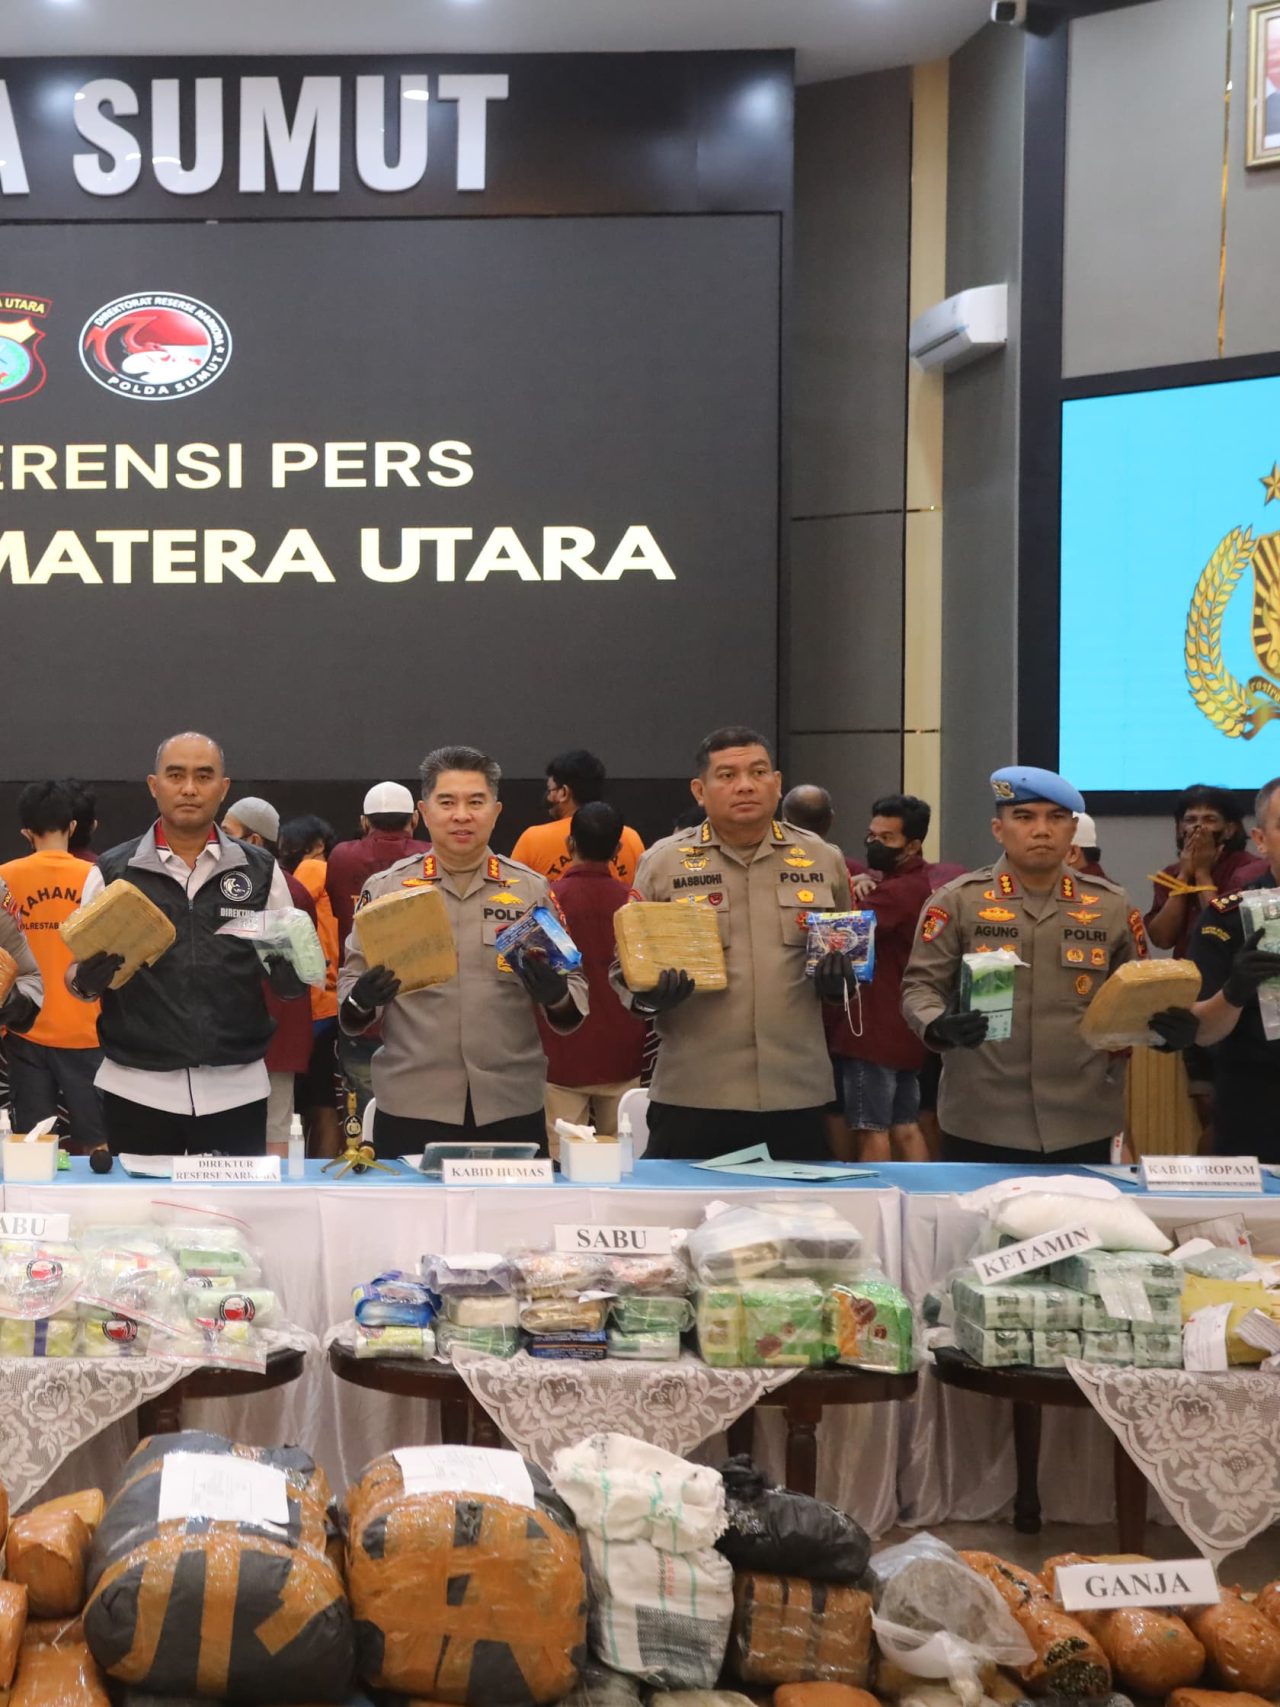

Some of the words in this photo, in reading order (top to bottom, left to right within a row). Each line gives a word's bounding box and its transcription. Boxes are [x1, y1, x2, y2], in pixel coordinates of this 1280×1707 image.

[72, 74, 509, 196] SUMUT
[5, 297, 45, 314] UTARA
[94, 297, 153, 326] DIREKTORAT
[154, 297, 197, 314] RESERSE
[107, 376, 169, 395] POLDA
[175, 355, 224, 392] SUMUT
[272, 440, 475, 488] PERS
[360, 525, 677, 582] UTARA
[780, 872, 824, 883] POLRI
[974, 925, 1019, 938] AGUNG
[1064, 928, 1107, 942] POLRI
[199, 1160, 254, 1168] DIREKTUR
[452, 1167, 493, 1177] KABID
[497, 1167, 545, 1177] HUMAS
[1148, 1165, 1192, 1174] KABID
[1196, 1165, 1255, 1175] PROPAM
[176, 1171, 221, 1180] RESERSE
[576, 1229, 647, 1249] SABU
[982, 1227, 1092, 1277] KETAMIN
[1084, 1571, 1192, 1598] GANJA
